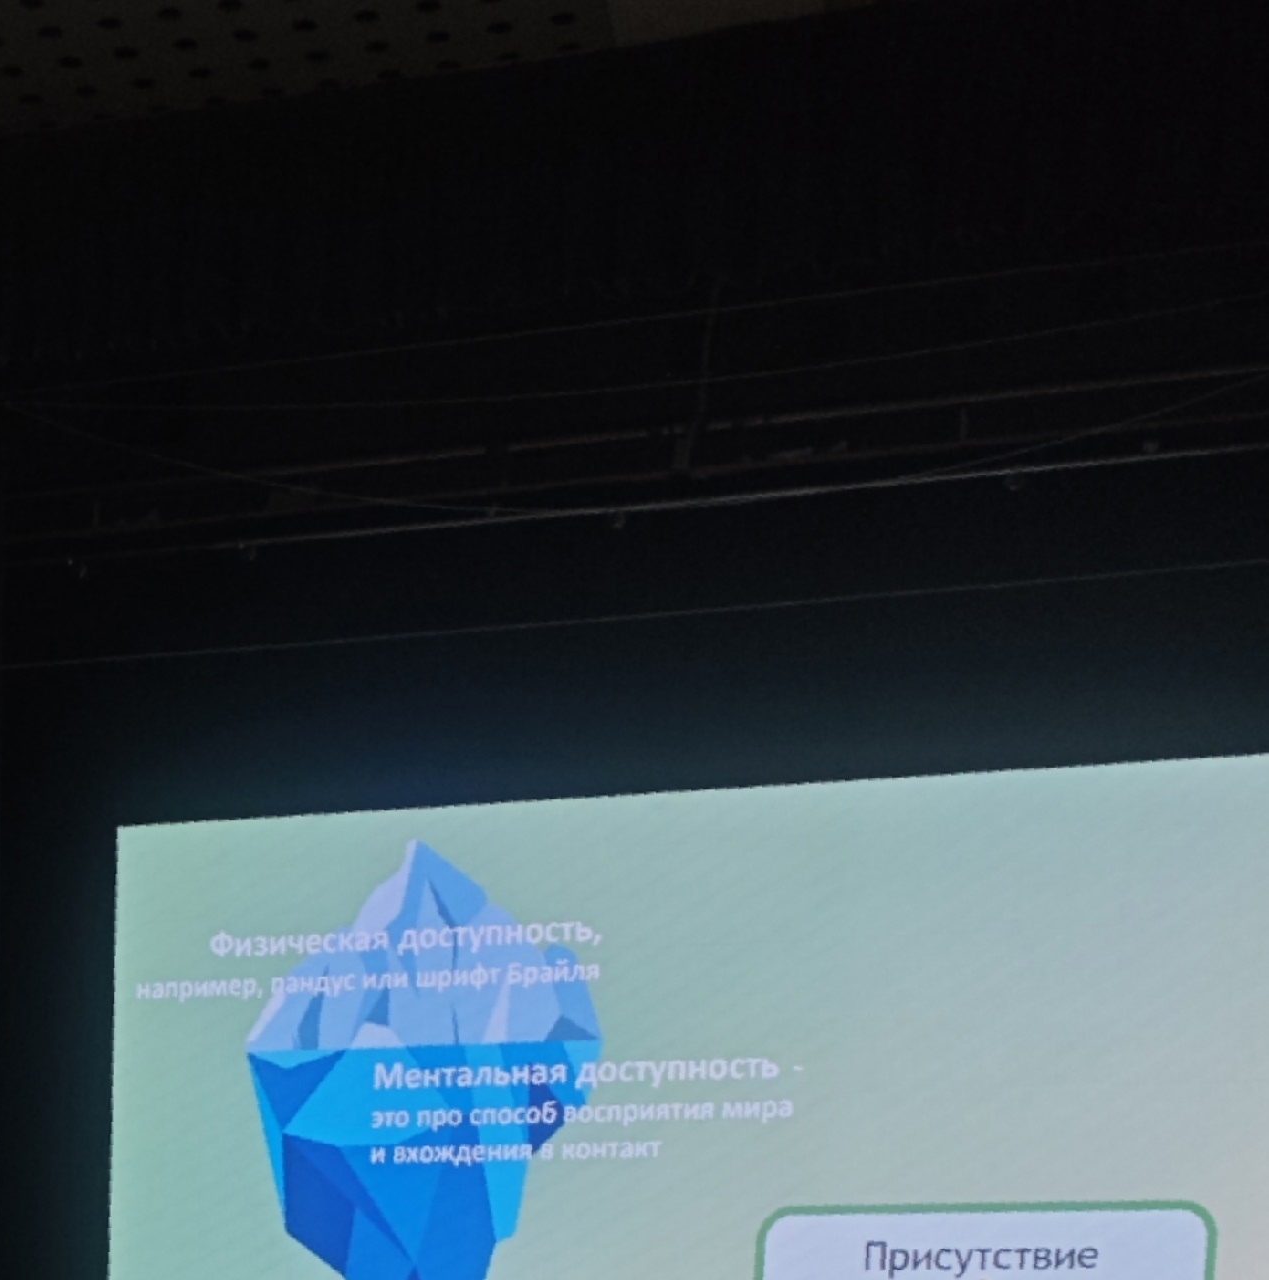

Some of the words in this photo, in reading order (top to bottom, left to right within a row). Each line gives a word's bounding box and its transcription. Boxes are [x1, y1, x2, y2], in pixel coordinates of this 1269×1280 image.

[209, 926, 389, 958] Физическая
[397, 919, 604, 955] доступность,
[135, 976, 263, 1002] например,
[271, 971, 356, 998] пандус
[361, 968, 408, 990] или
[416, 964, 502, 992] шрифт
[507, 959, 601, 987] Брайля
[373, 1062, 567, 1089] Ментальная
[575, 1056, 780, 1089] доступность
[370, 1111, 410, 1129] это
[416, 1109, 463, 1132] про
[469, 1101, 557, 1128] способ
[563, 1103, 714, 1127] восприятия
[722, 1098, 795, 1122] мира
[370, 1147, 386, 1164] и
[393, 1143, 532, 1167] вхождения
[539, 1144, 554, 1160] в
[561, 1141, 661, 1160] контакт
[864, 1240, 1099, 1278] Присутствие
